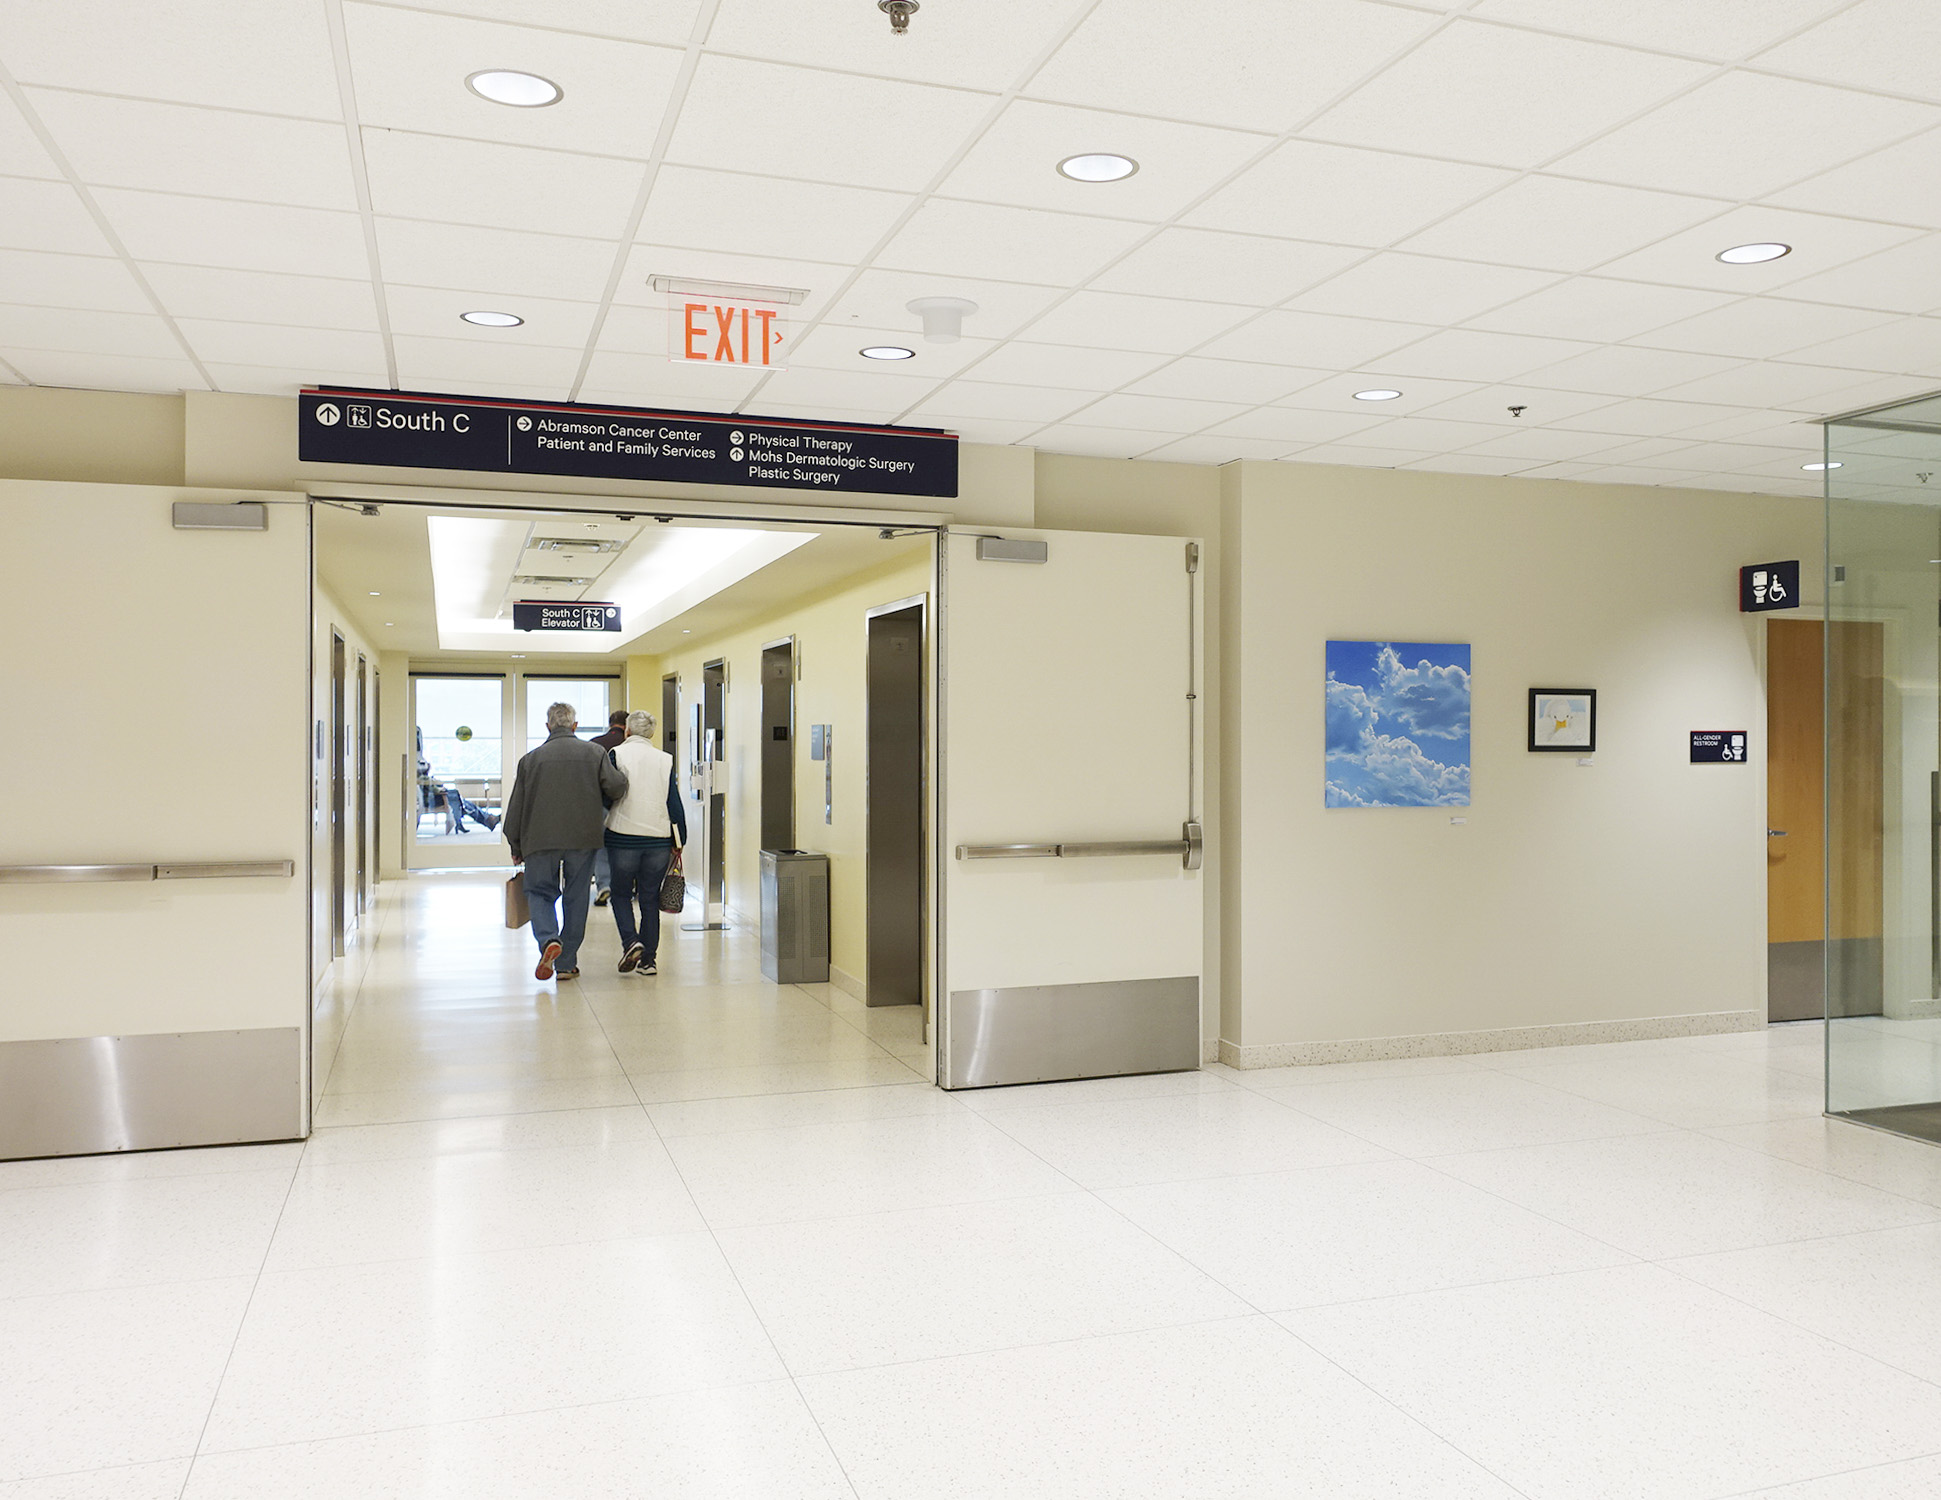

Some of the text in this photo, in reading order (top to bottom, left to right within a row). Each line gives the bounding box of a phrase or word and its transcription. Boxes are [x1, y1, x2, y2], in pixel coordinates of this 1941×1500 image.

[684, 303, 776, 365] EXIT
[376, 408, 470, 433] South C
[537, 419, 702, 442] Abramson Cancer Center
[537, 436, 716, 459] Patient and Family Services
[749, 433, 853, 454] Physical Therapy
[749, 449, 915, 473] Mohs Dermatologic Surgery
[749, 465, 841, 485] Plastic Surgery
[541, 618, 580, 628] Elevator
[542, 608, 580, 618] South C
